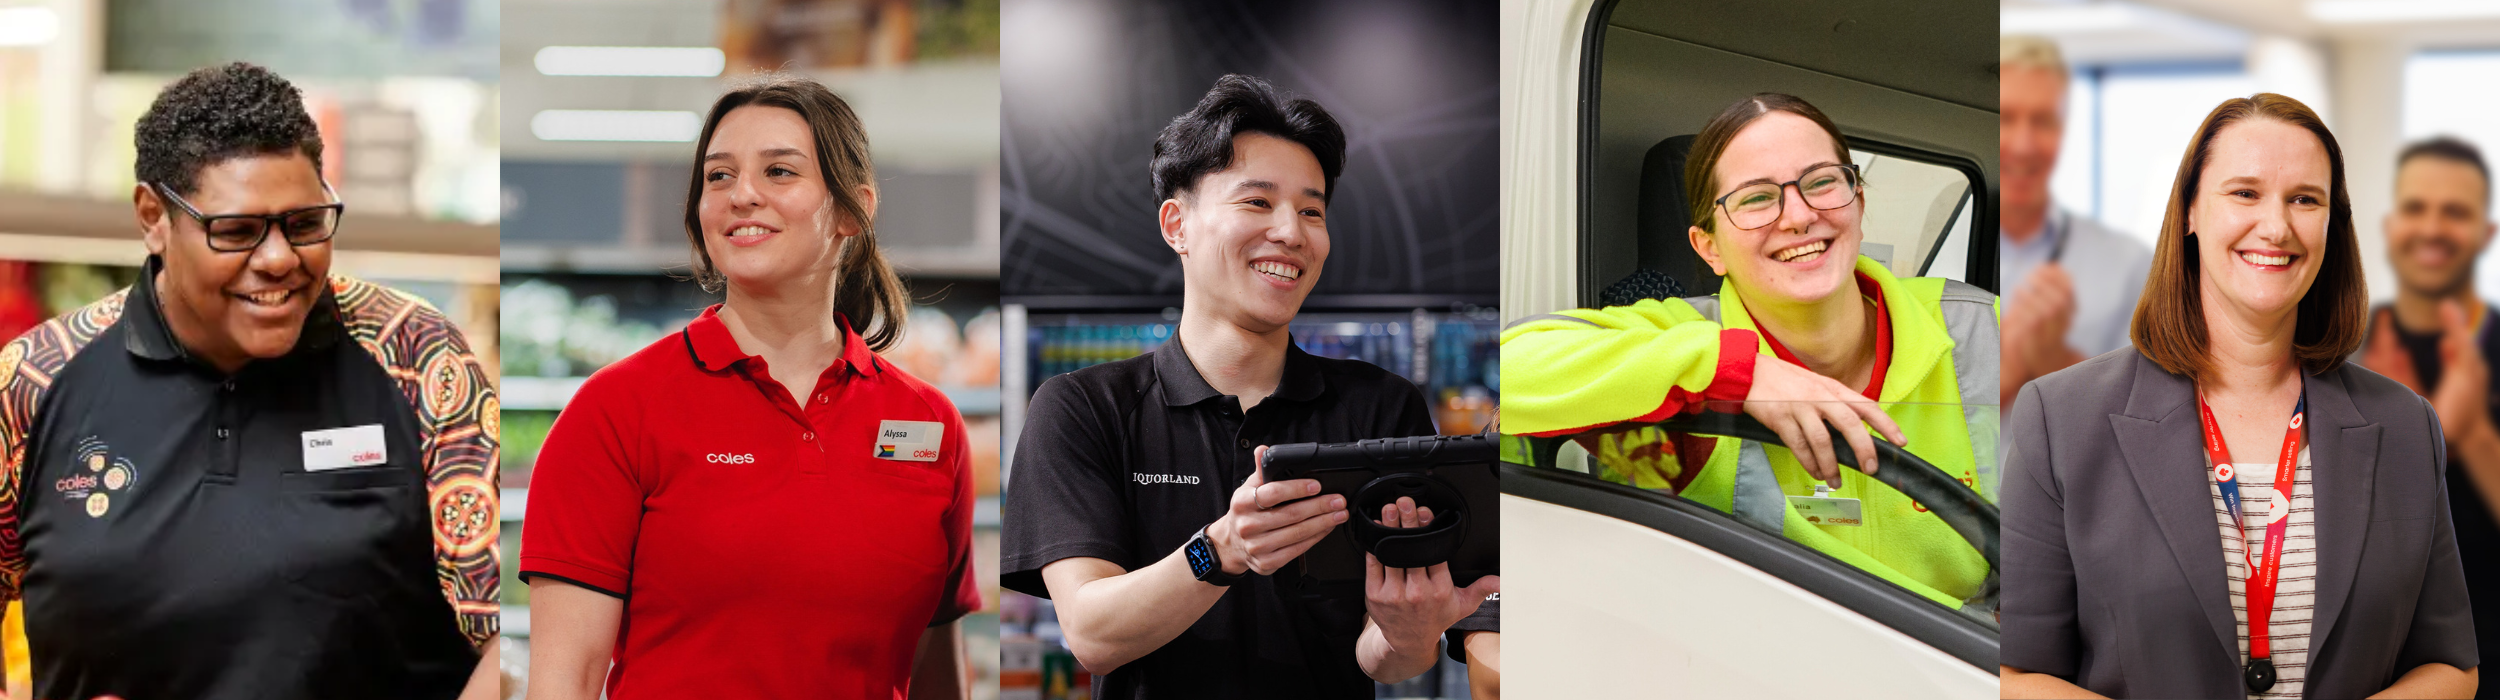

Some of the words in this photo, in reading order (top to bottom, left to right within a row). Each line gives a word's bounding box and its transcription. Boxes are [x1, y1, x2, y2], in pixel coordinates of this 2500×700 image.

[883, 429, 908, 439] Alyssa
[2212, 434, 2220, 451] selling
[352, 451, 381, 462] coles
[706, 452, 755, 465] coles
[913, 449, 937, 458] coles
[2282, 459, 2291, 482] Smarter
[2287, 441, 2296, 459] selling
[56, 474, 97, 491] coles
[1827, 517, 1860, 525] coles
[2268, 534, 2279, 566] customers
[2264, 566, 2273, 588] Inspire
